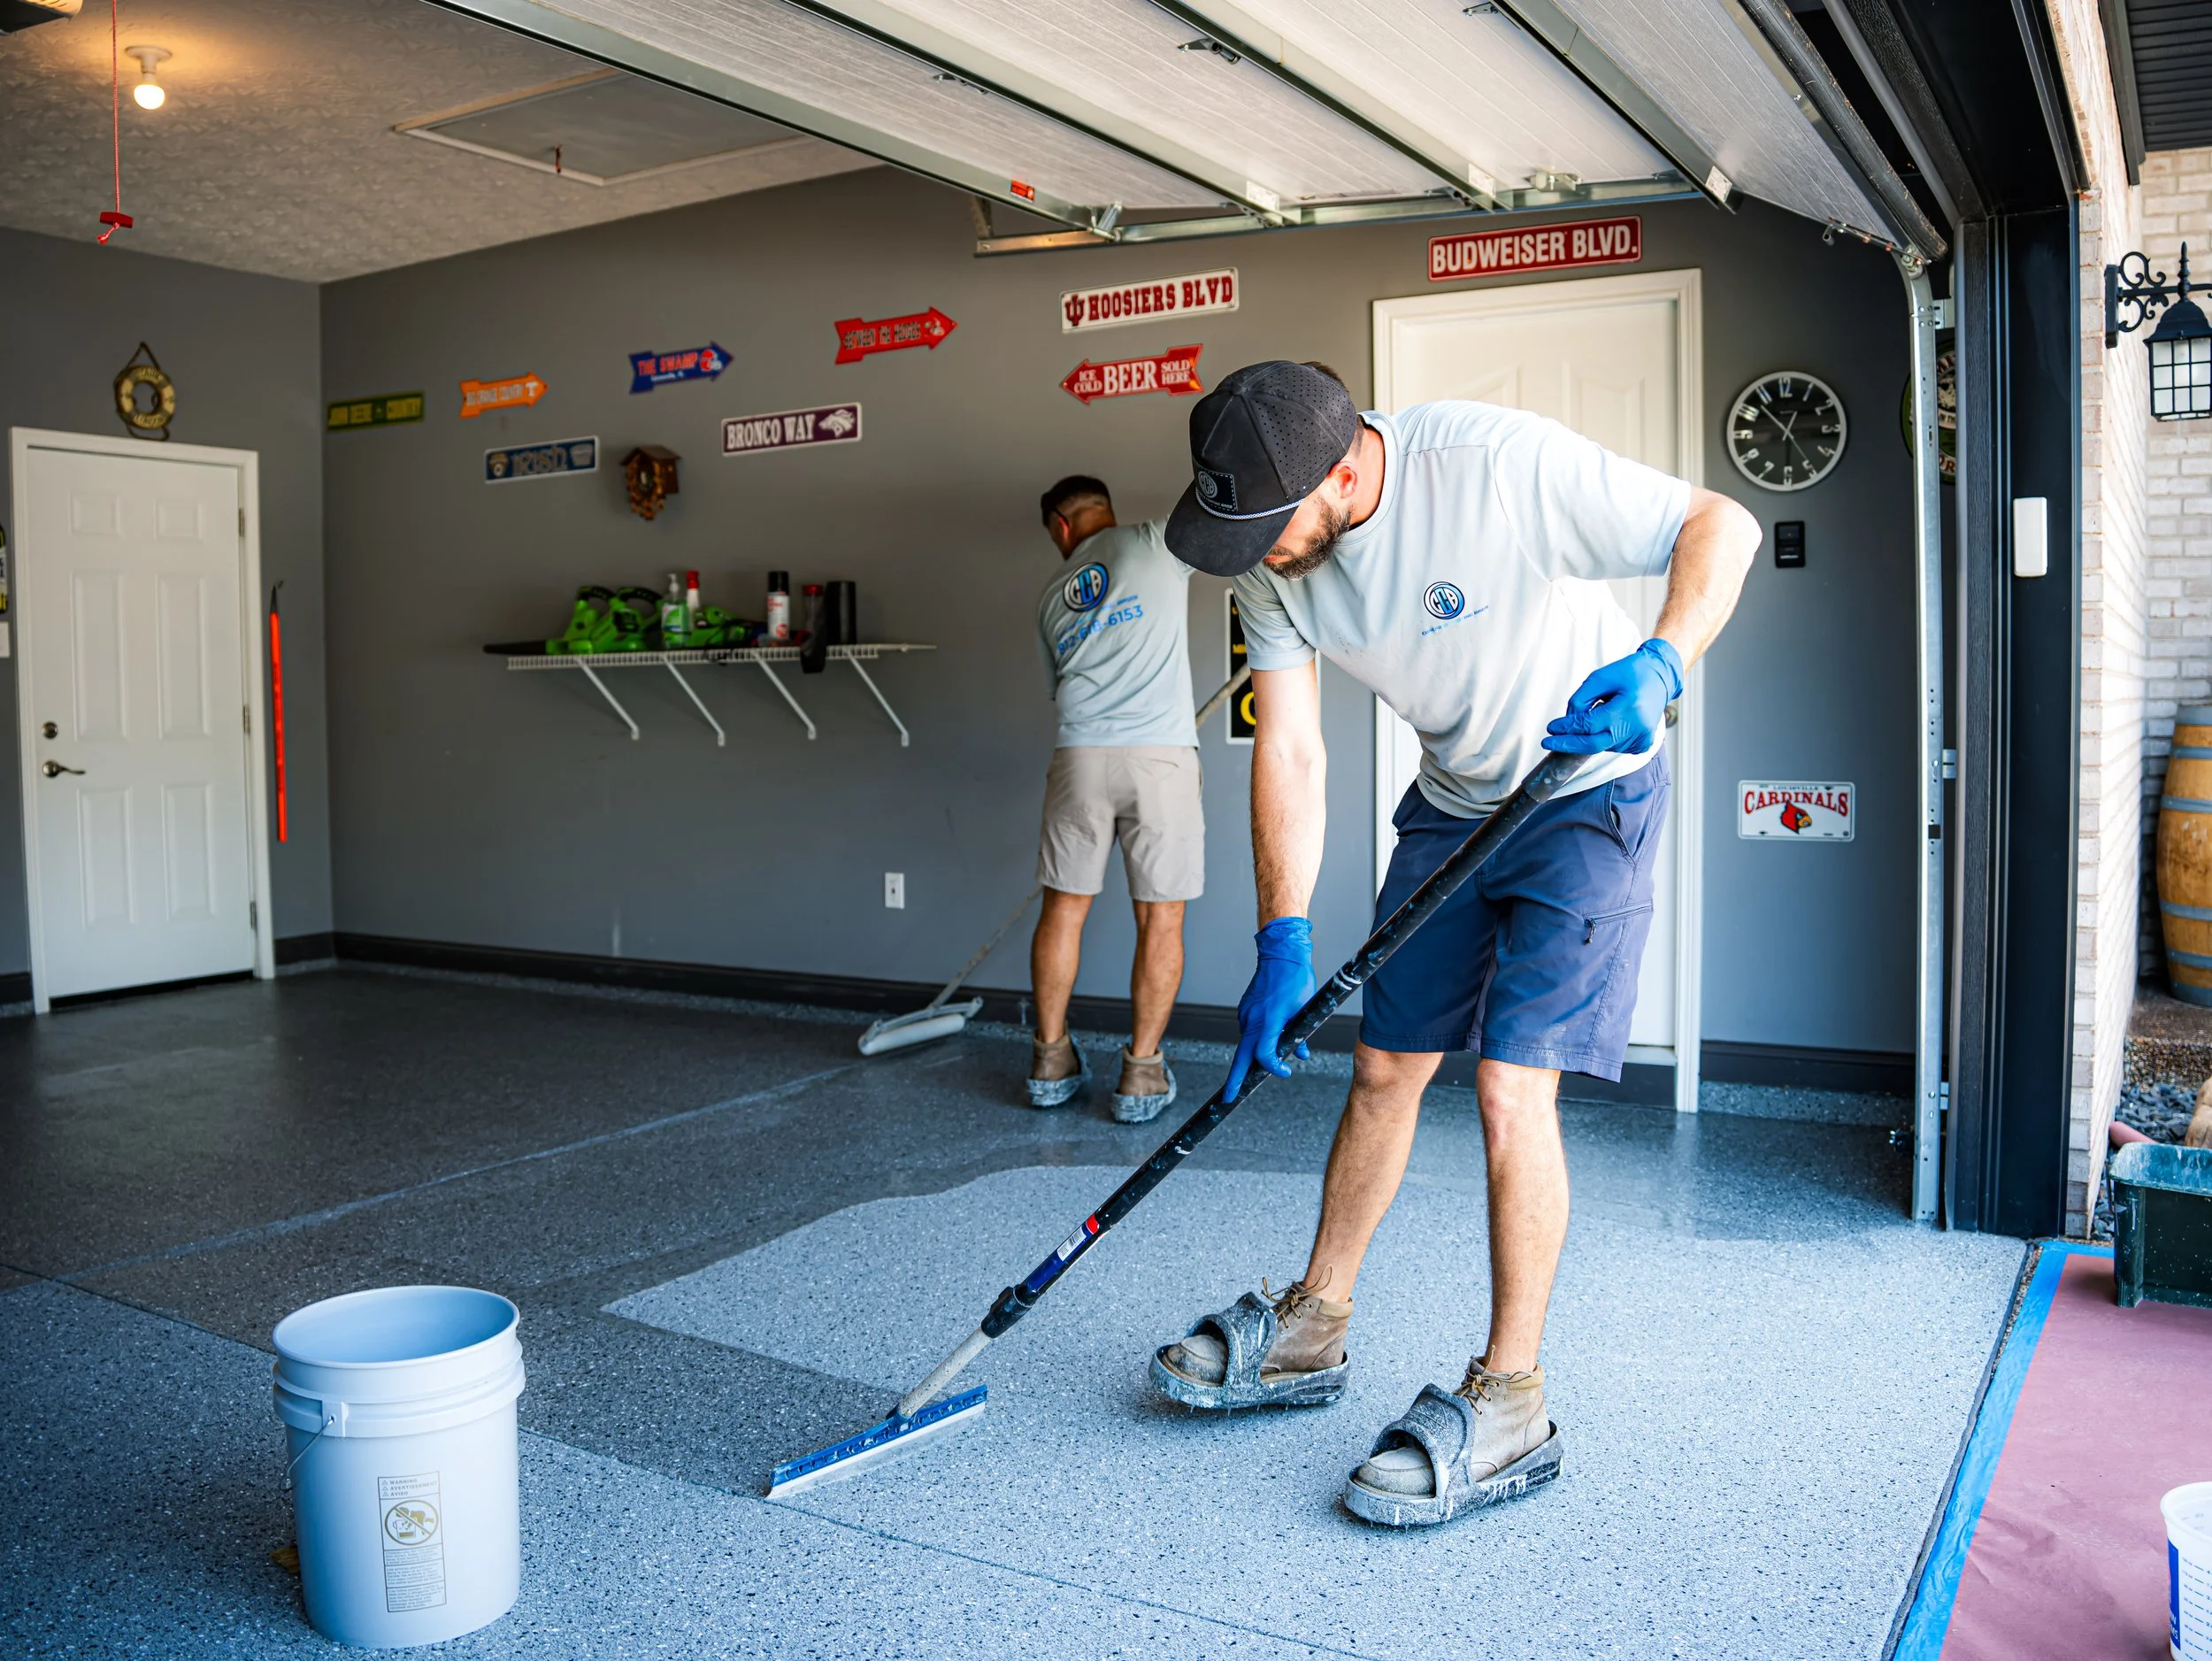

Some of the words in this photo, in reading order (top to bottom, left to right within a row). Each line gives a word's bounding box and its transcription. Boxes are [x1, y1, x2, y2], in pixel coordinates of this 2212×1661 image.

[1432, 230, 1565, 273] BUDWEISER
[1572, 225, 1637, 258] BLVD.
[1088, 283, 1175, 321] HOOSIERS
[1182, 275, 1233, 308] BLVD
[843, 327, 875, 350] BETWEEN
[878, 325, 890, 344] THE
[894, 321, 921, 342] HEDGES
[637, 358, 657, 376] THE
[659, 351, 698, 373] SWAMP
[1161, 358, 1190, 373] SOLD
[1079, 369, 1097, 381] ICE
[1103, 360, 1158, 395] BEER
[1162, 372, 1190, 385] HERE
[1074, 381, 1102, 394] COLD
[1778, 377, 1793, 398] 12
[1738, 403, 1759, 422] 10
[1815, 398, 1834, 416] 2
[726, 417, 781, 450] BRONCO
[783, 413, 817, 442] WAY
[1734, 429, 1753, 440] 9
[1822, 424, 1840, 434] 3
[1740, 448, 1760, 465] 8
[1817, 445, 1835, 458] 4
[1758, 461, 1775, 480] 7
[1783, 465, 1793, 486] 6
[1802, 459, 1817, 479] 5
[1427, 585, 1461, 616] CCB
[1744, 790, 1848, 817] CARDINALS
